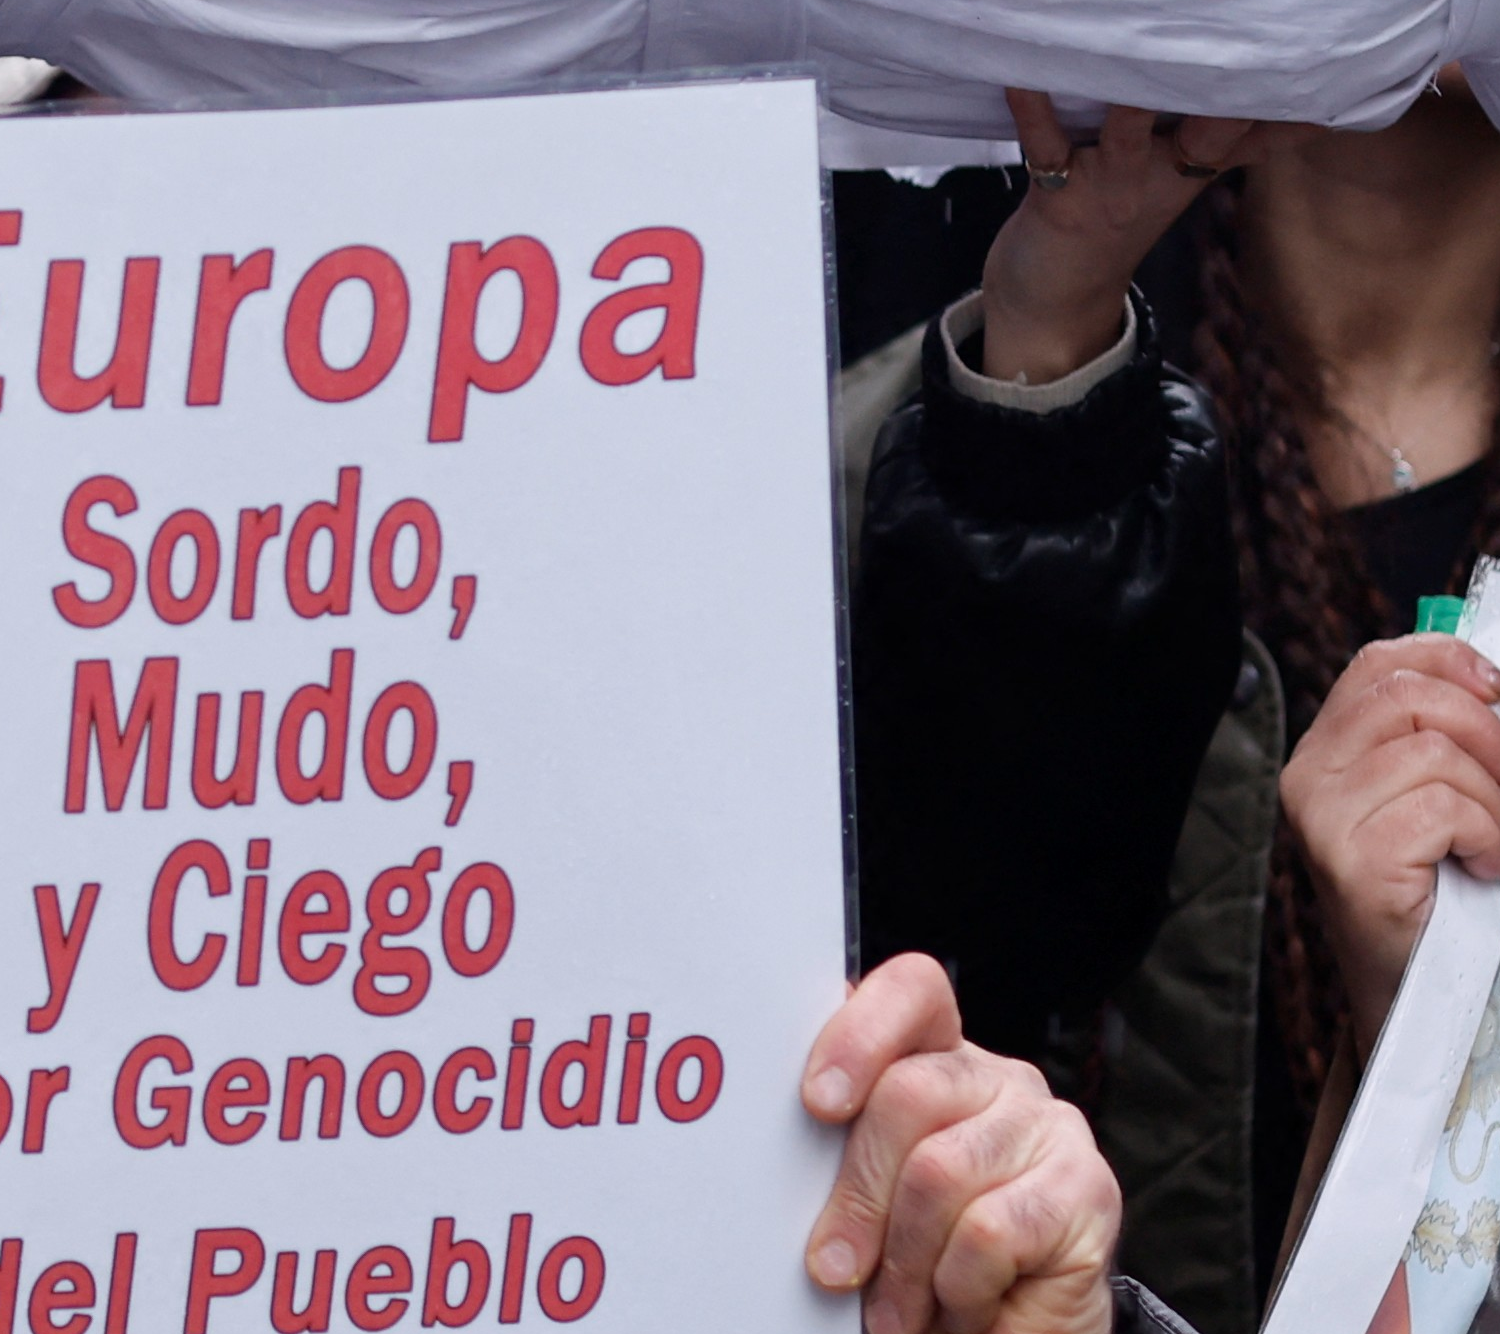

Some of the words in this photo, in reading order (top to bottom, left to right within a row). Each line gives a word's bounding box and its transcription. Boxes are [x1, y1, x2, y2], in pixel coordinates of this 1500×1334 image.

[50, 467, 478, 640] Sordo,
[62, 648, 475, 827] Mudo,
[25, 882, 100, 1033] y
[146, 838, 516, 1017] Ciego
[112, 1013, 727, 1152] Genocidio
